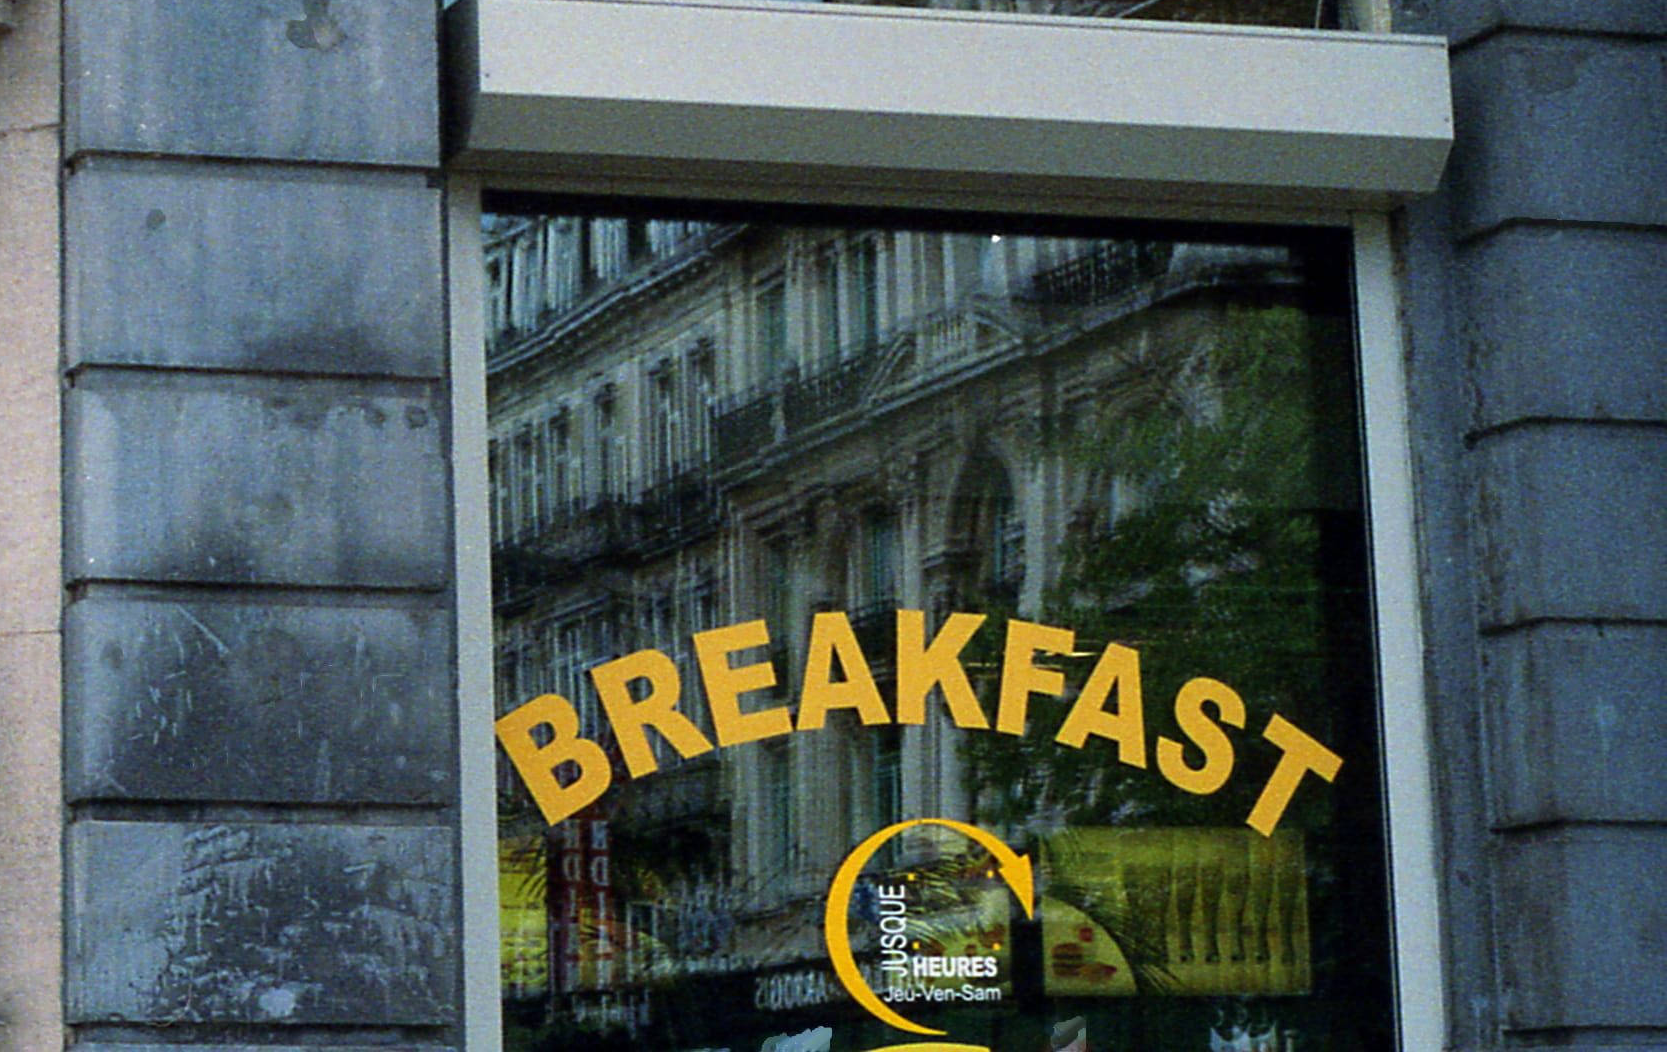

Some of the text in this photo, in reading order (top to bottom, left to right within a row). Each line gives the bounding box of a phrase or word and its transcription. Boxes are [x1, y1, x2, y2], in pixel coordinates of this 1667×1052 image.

[495, 609, 1344, 838] BREAKFAST
[878, 884, 908, 978] JUSQUE
[883, 983, 1002, 1003] Jeu-Ven-Sam
[912, 955, 999, 978] HEURES
